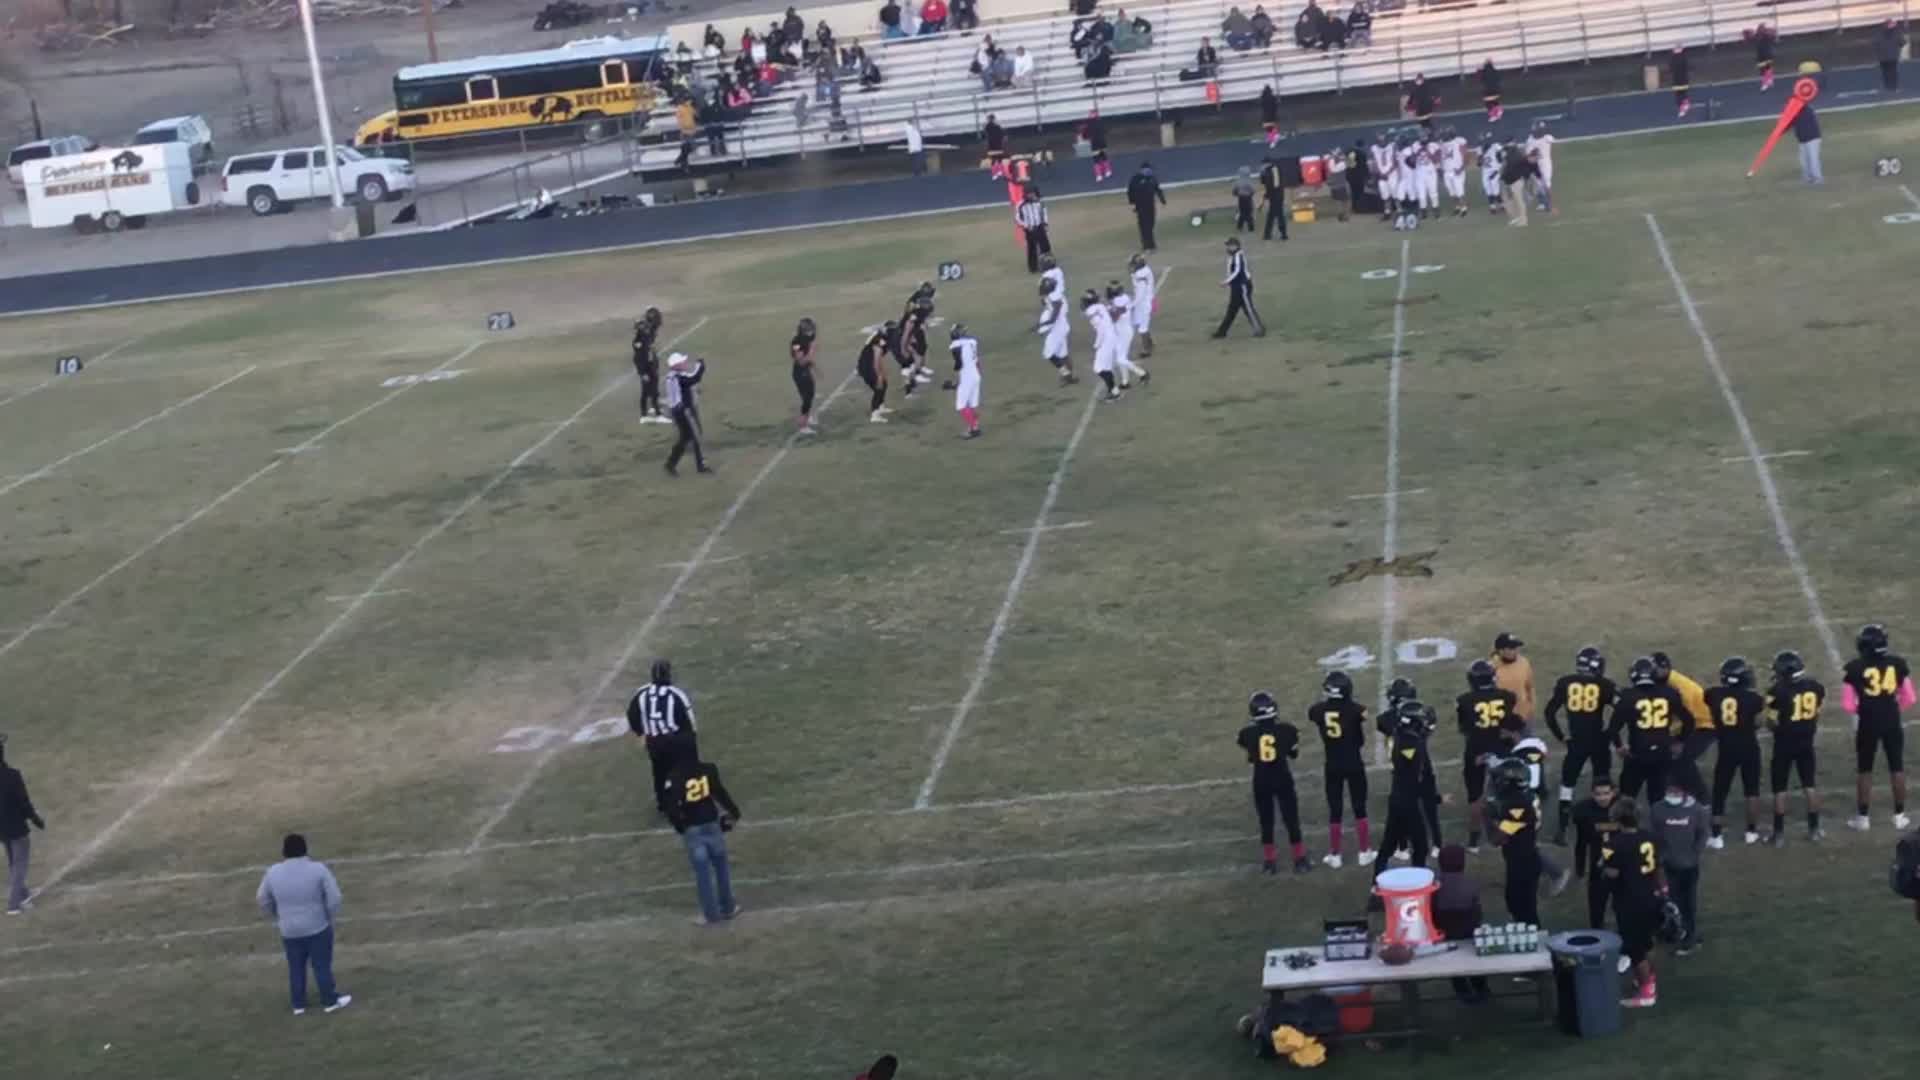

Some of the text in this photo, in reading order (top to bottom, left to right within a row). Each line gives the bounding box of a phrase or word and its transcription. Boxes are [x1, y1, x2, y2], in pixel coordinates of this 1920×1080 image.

[430, 99, 528, 124] PETERSBURG
[1878, 158, 1901, 176] 30
[59, 357, 78, 376] 10
[1863, 666, 1897, 697] 34
[1567, 682, 1600, 712] 88
[1791, 691, 1817, 722] 19
[1324, 711, 1342, 738] 5
[1474, 700, 1505, 728] 35
[1635, 698, 1669, 729] 32
[1721, 697, 1738, 726] 8
[1258, 734, 1277, 762] 6
[685, 775, 710, 801] 21
[1640, 841, 1656, 874] 3
[1400, 900, 1419, 922] G
